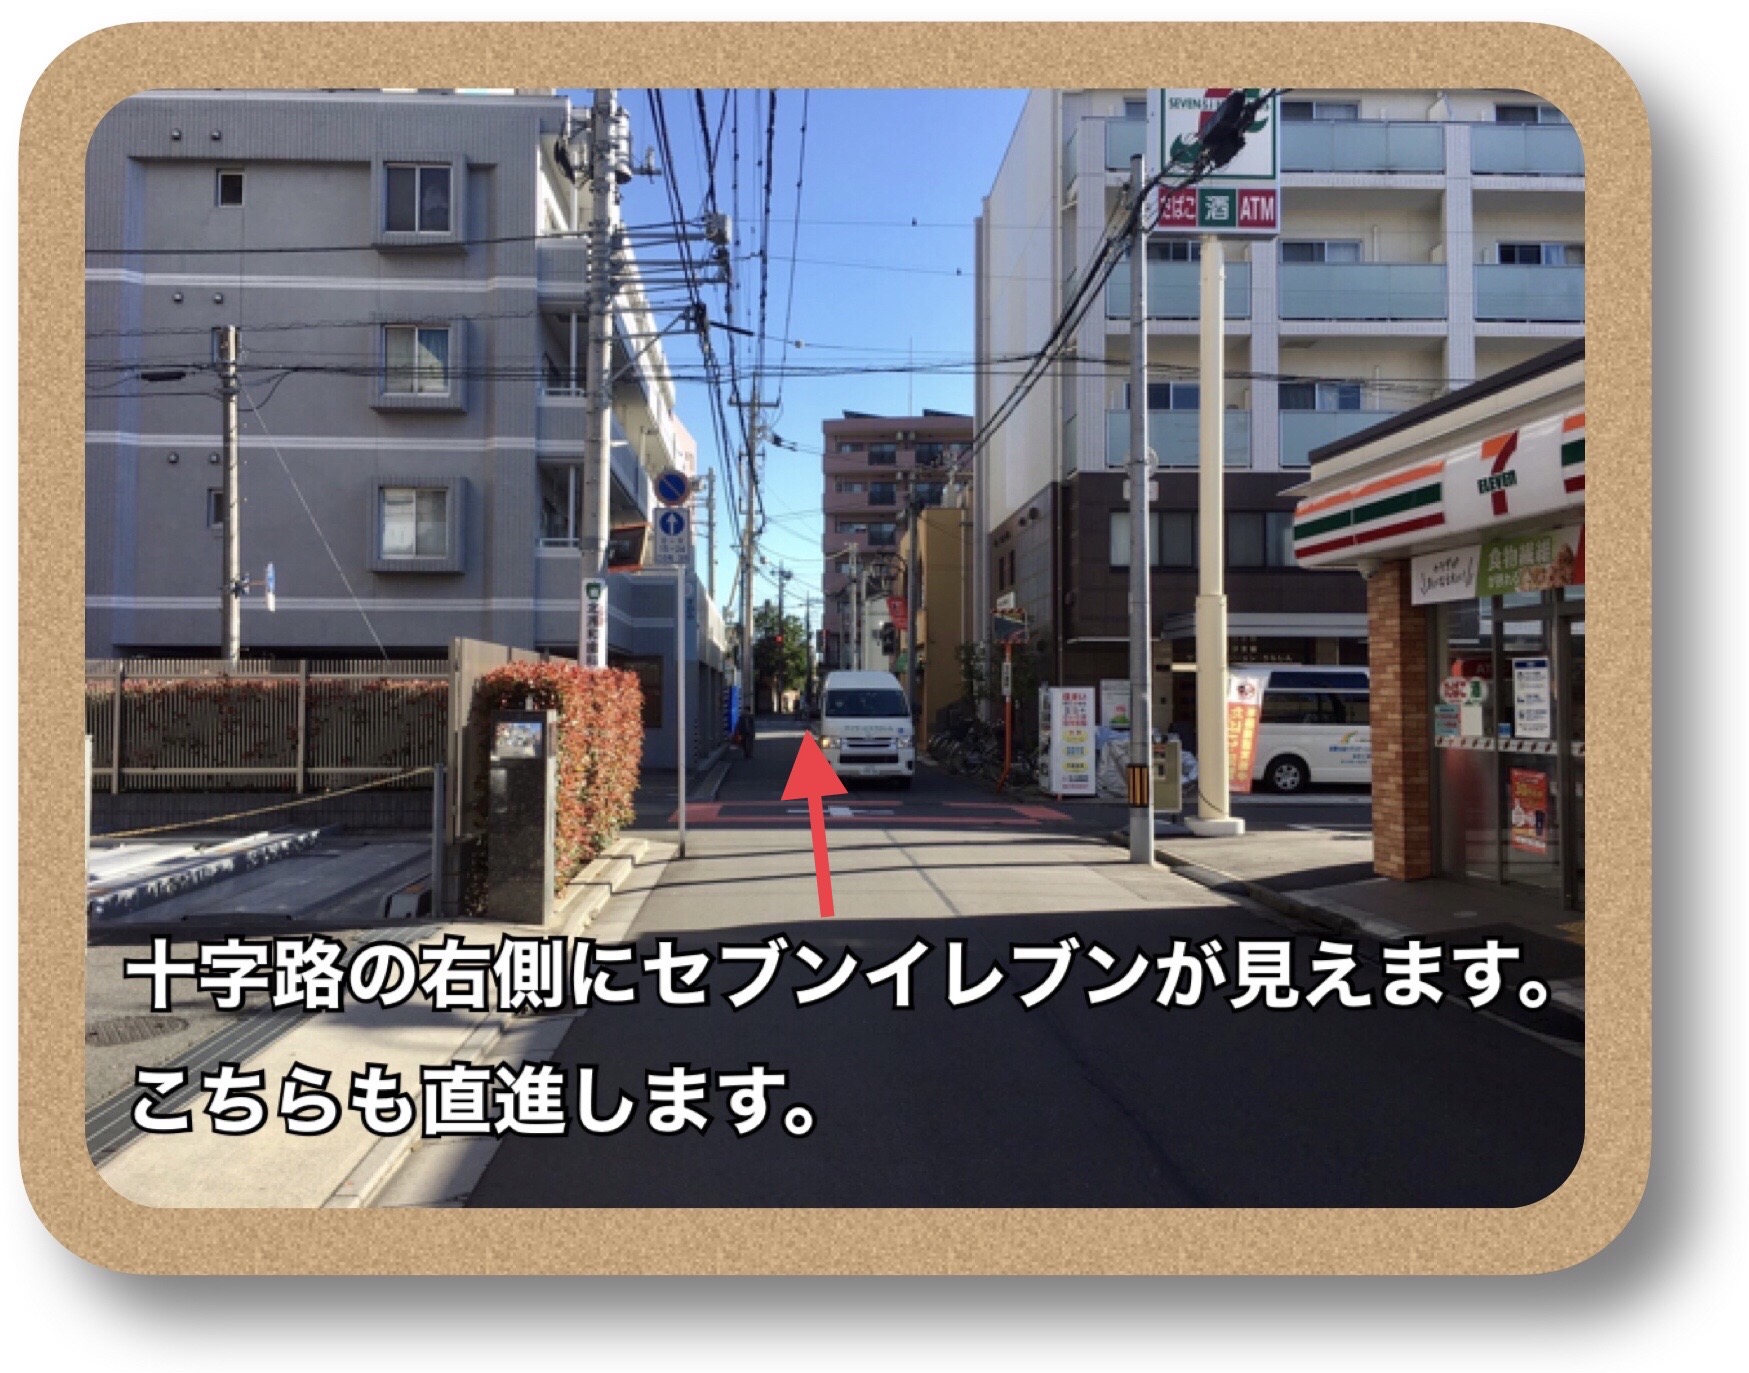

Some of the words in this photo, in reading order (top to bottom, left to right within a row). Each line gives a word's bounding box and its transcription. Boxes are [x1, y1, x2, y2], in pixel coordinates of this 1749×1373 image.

[1160, 195, 1196, 219] たばこ
[1204, 195, 1230, 220] 酒
[1240, 195, 1275, 221] ATM
